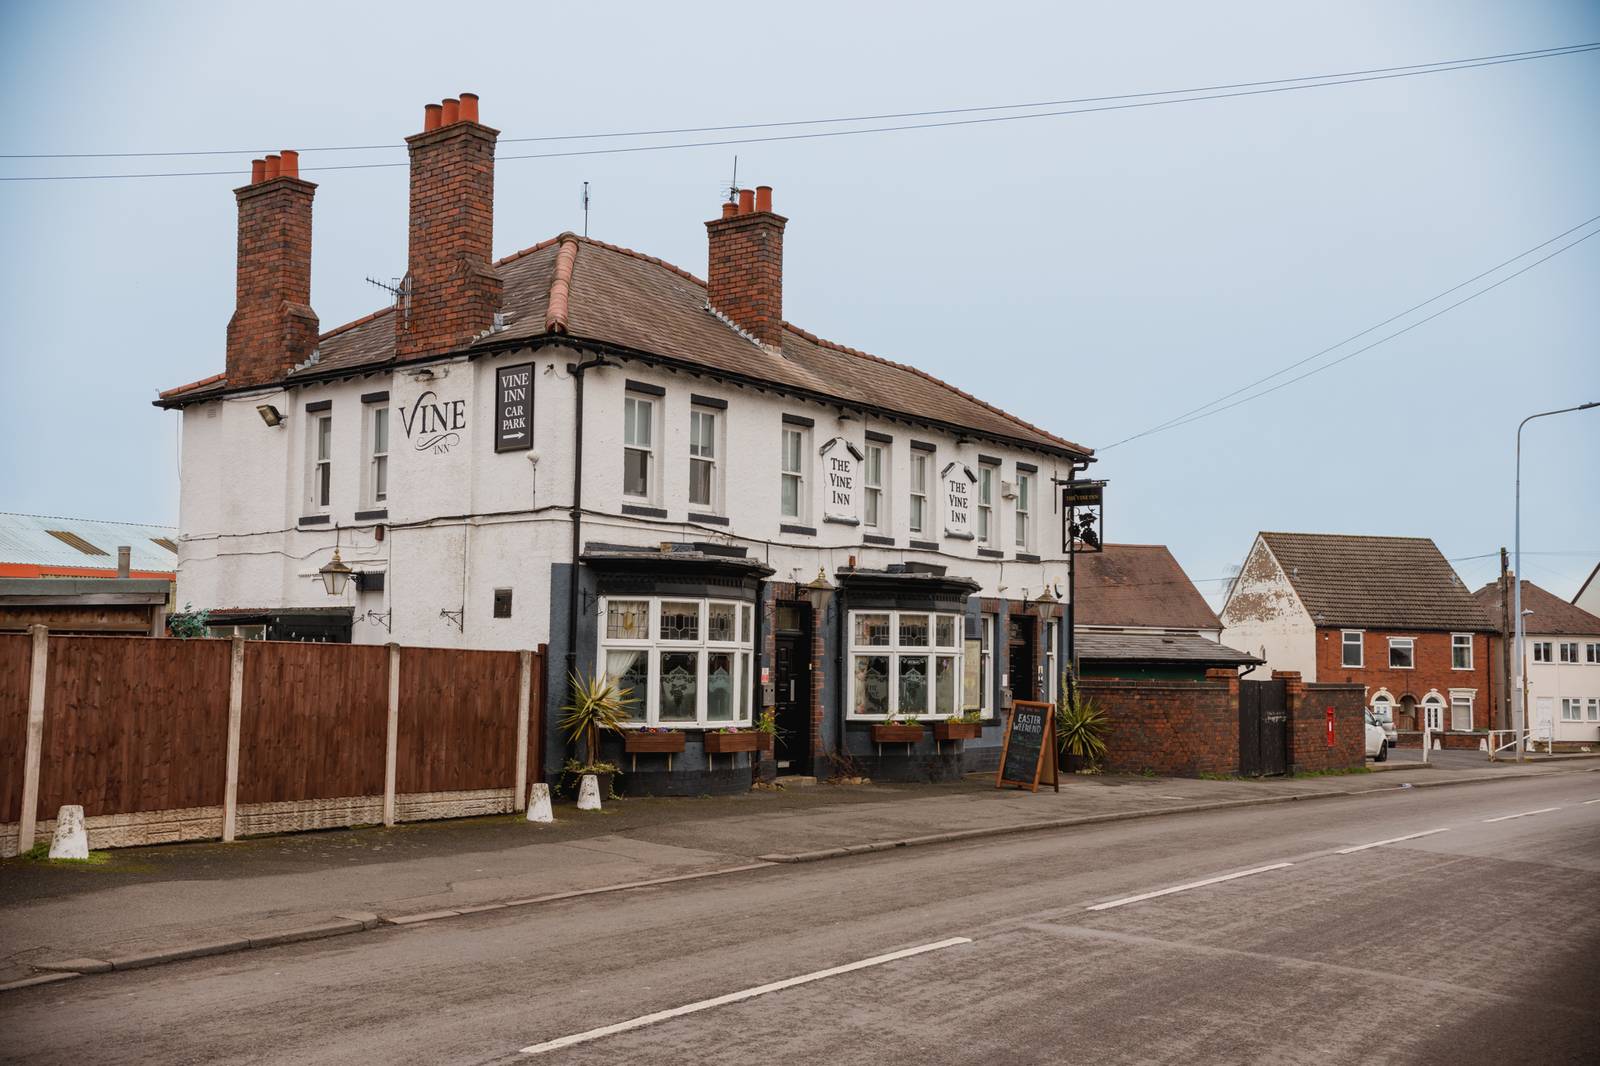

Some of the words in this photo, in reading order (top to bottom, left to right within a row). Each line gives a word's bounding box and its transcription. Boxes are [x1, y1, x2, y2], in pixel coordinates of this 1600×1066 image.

[501, 373, 529, 389] VINE
[504, 388, 526, 403] INN
[398, 390, 466, 439] VINE
[505, 405, 524, 417] CAR
[503, 417, 526, 430] PARK
[433, 444, 450, 455] INN
[830, 457, 851, 473] THE
[829, 473, 852, 490] VINE
[949, 480, 967, 494] THE
[832, 490, 851, 506] INN
[948, 494, 968, 509] VINE
[951, 510, 967, 524] INN
[1018, 713, 1041, 724] EASTER
